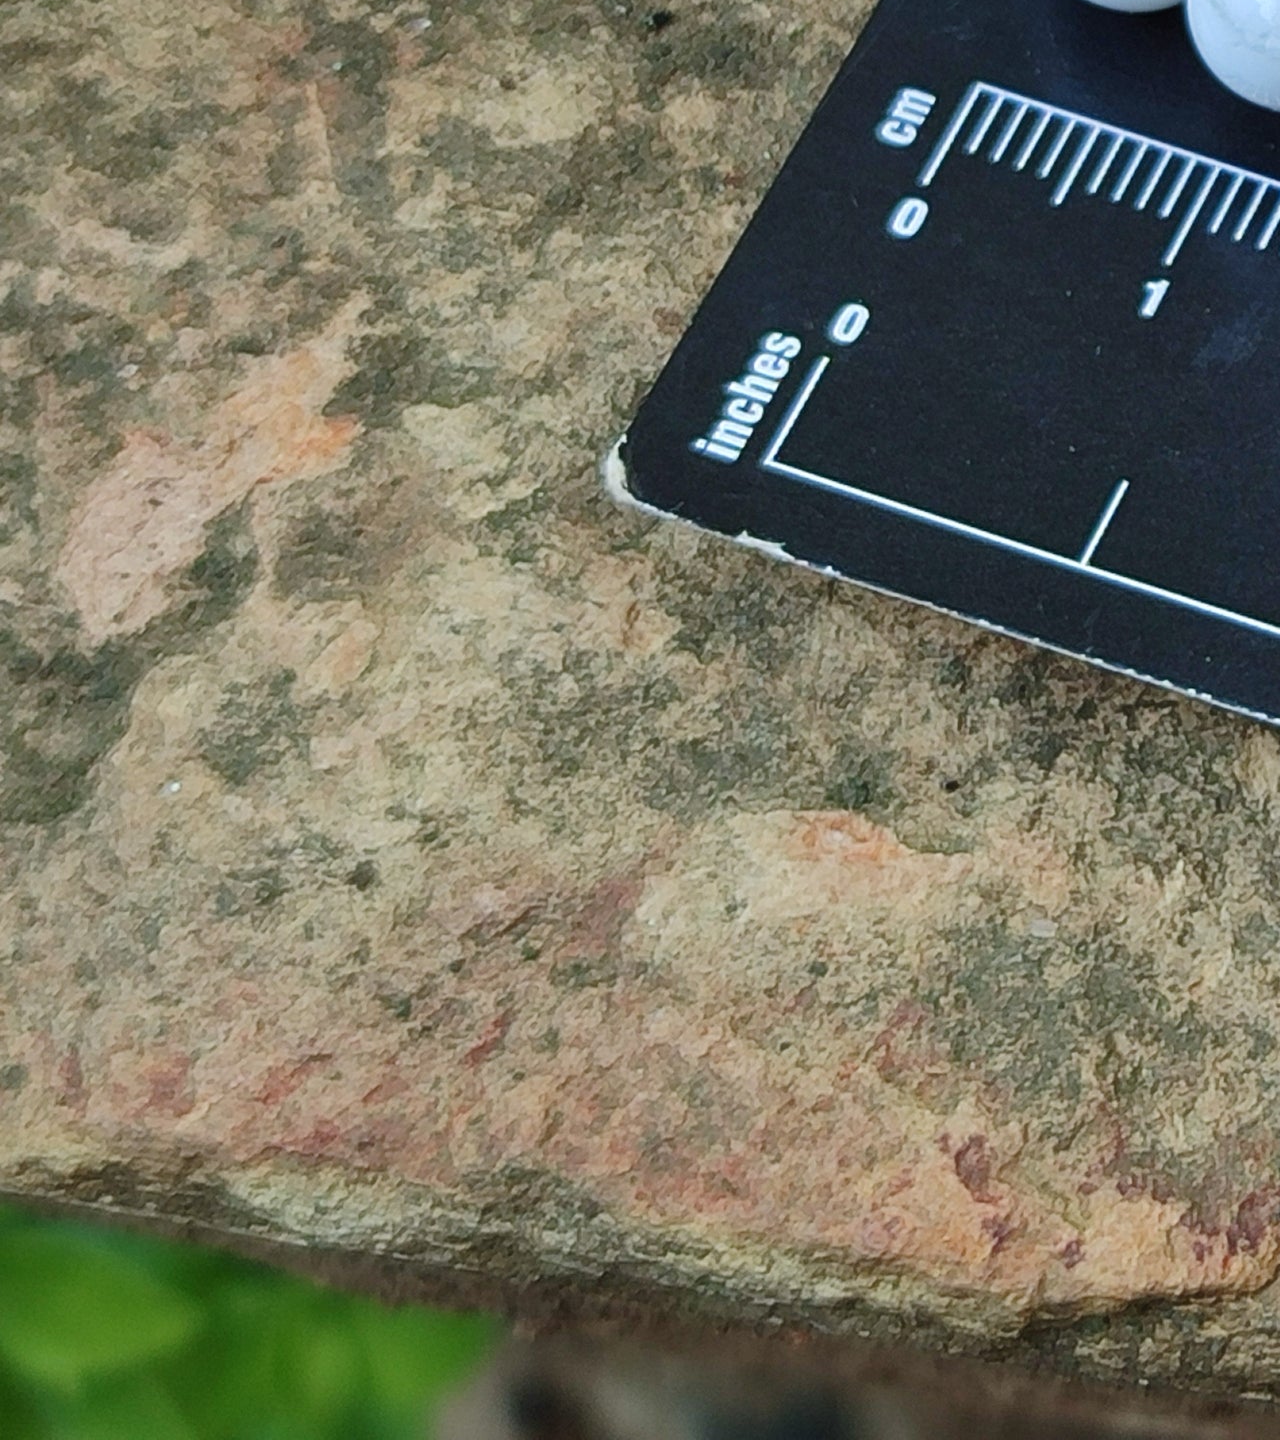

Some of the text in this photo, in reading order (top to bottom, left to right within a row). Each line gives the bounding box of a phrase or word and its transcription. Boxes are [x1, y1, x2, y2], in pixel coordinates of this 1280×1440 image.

[877, 88, 936, 147] cm
[889, 197, 929, 238] 0
[1140, 278, 1170, 318] 1
[828, 303, 870, 344] 0
[692, 331, 803, 463] inches
